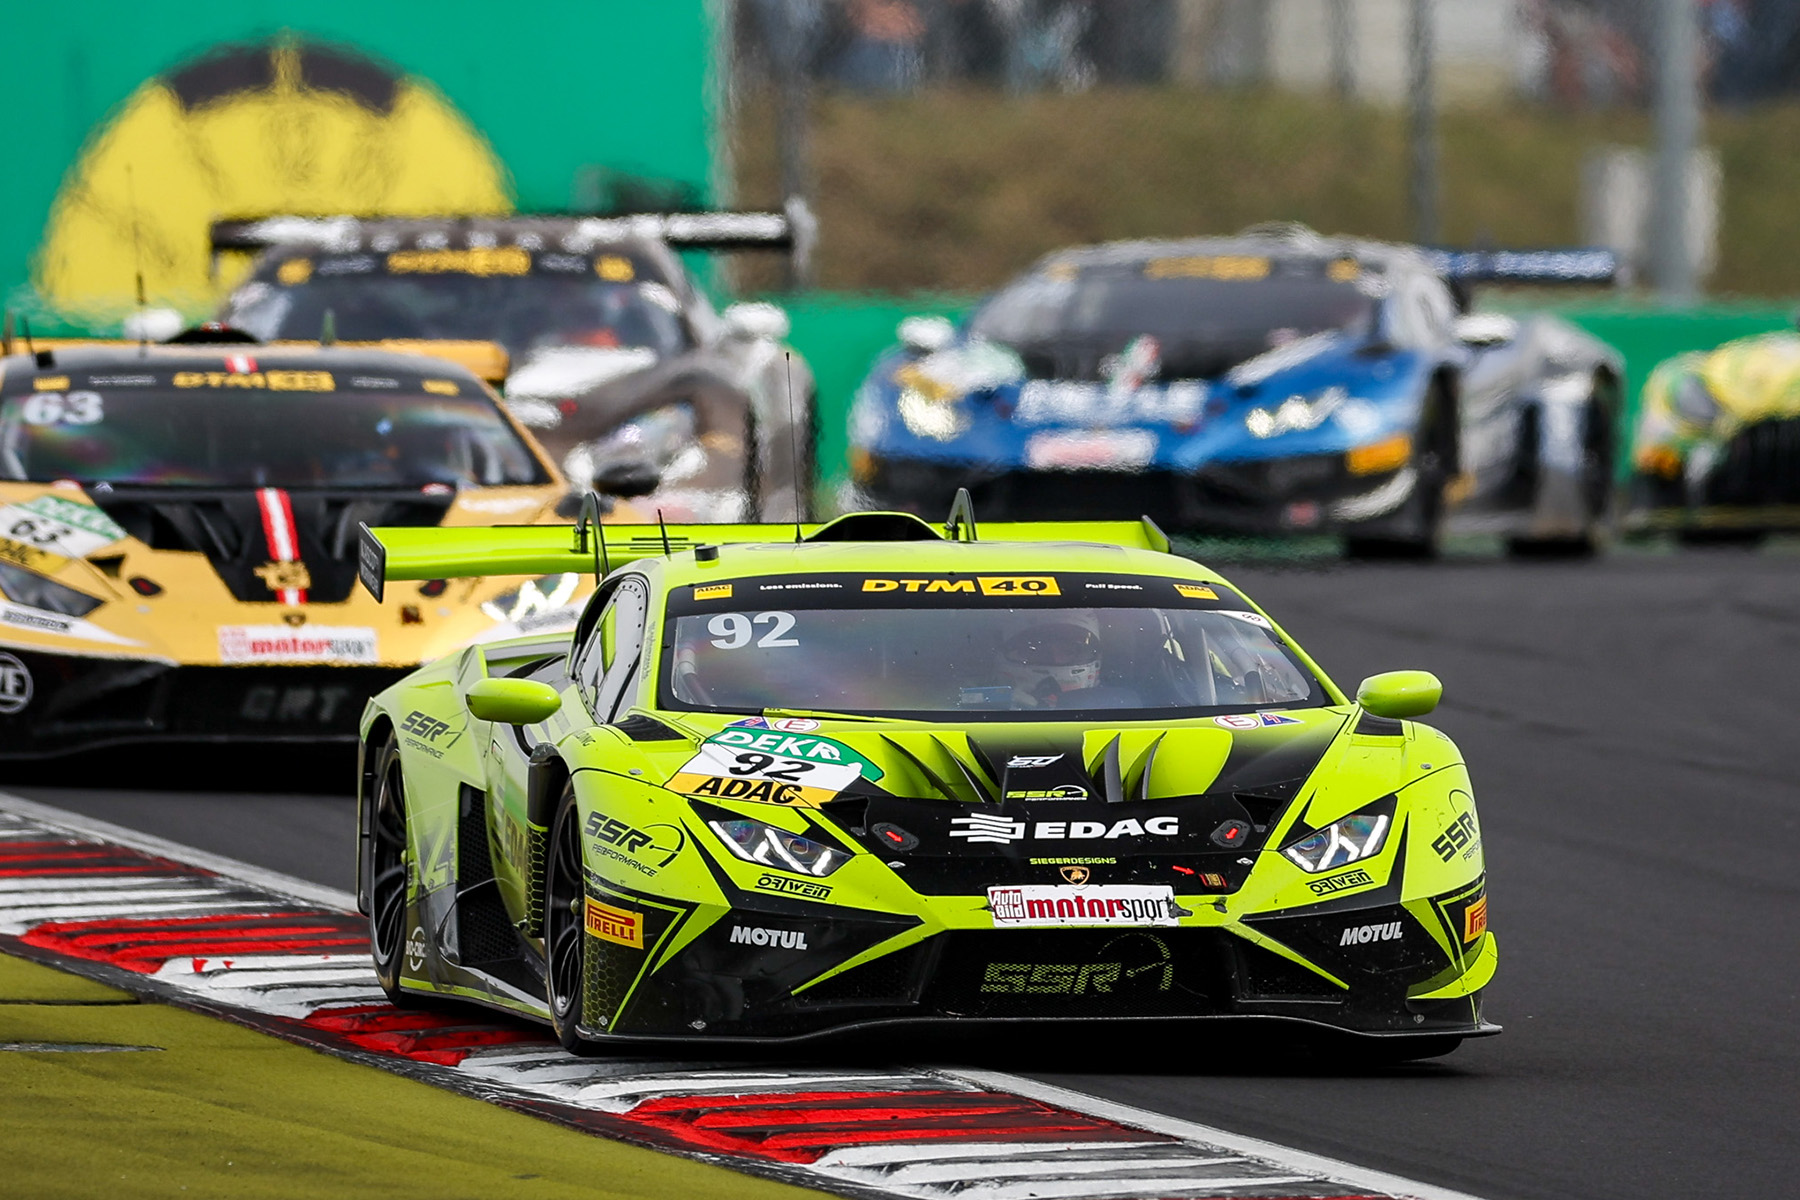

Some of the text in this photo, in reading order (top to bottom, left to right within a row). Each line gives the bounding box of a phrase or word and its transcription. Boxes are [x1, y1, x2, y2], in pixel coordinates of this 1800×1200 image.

[23, 390, 104, 425] 63
[696, 584, 731, 593] ADAC
[861, 579, 976, 592] DTM
[1107, 583, 1143, 591] Speed.
[707, 610, 800, 650] 92
[400, 709, 450, 742] SSR
[728, 752, 816, 782] 92
[693, 777, 803, 804] ADAC
[1006, 790, 1066, 799] SSR
[584, 810, 653, 854] SSR
[1034, 816, 1179, 840] EDAG
[1431, 811, 1477, 863] SSR
[592, 843, 658, 877] PERFORMANCE
[1029, 857, 1117, 865] SIEGERDESIGNS
[992, 889, 1022, 906] Auto
[587, 903, 636, 941] PIRELLI
[995, 904, 1025, 918] Bild
[729, 925, 808, 950] MOTUL
[1339, 921, 1403, 947] MOTUL
[980, 962, 1122, 995] SSR
